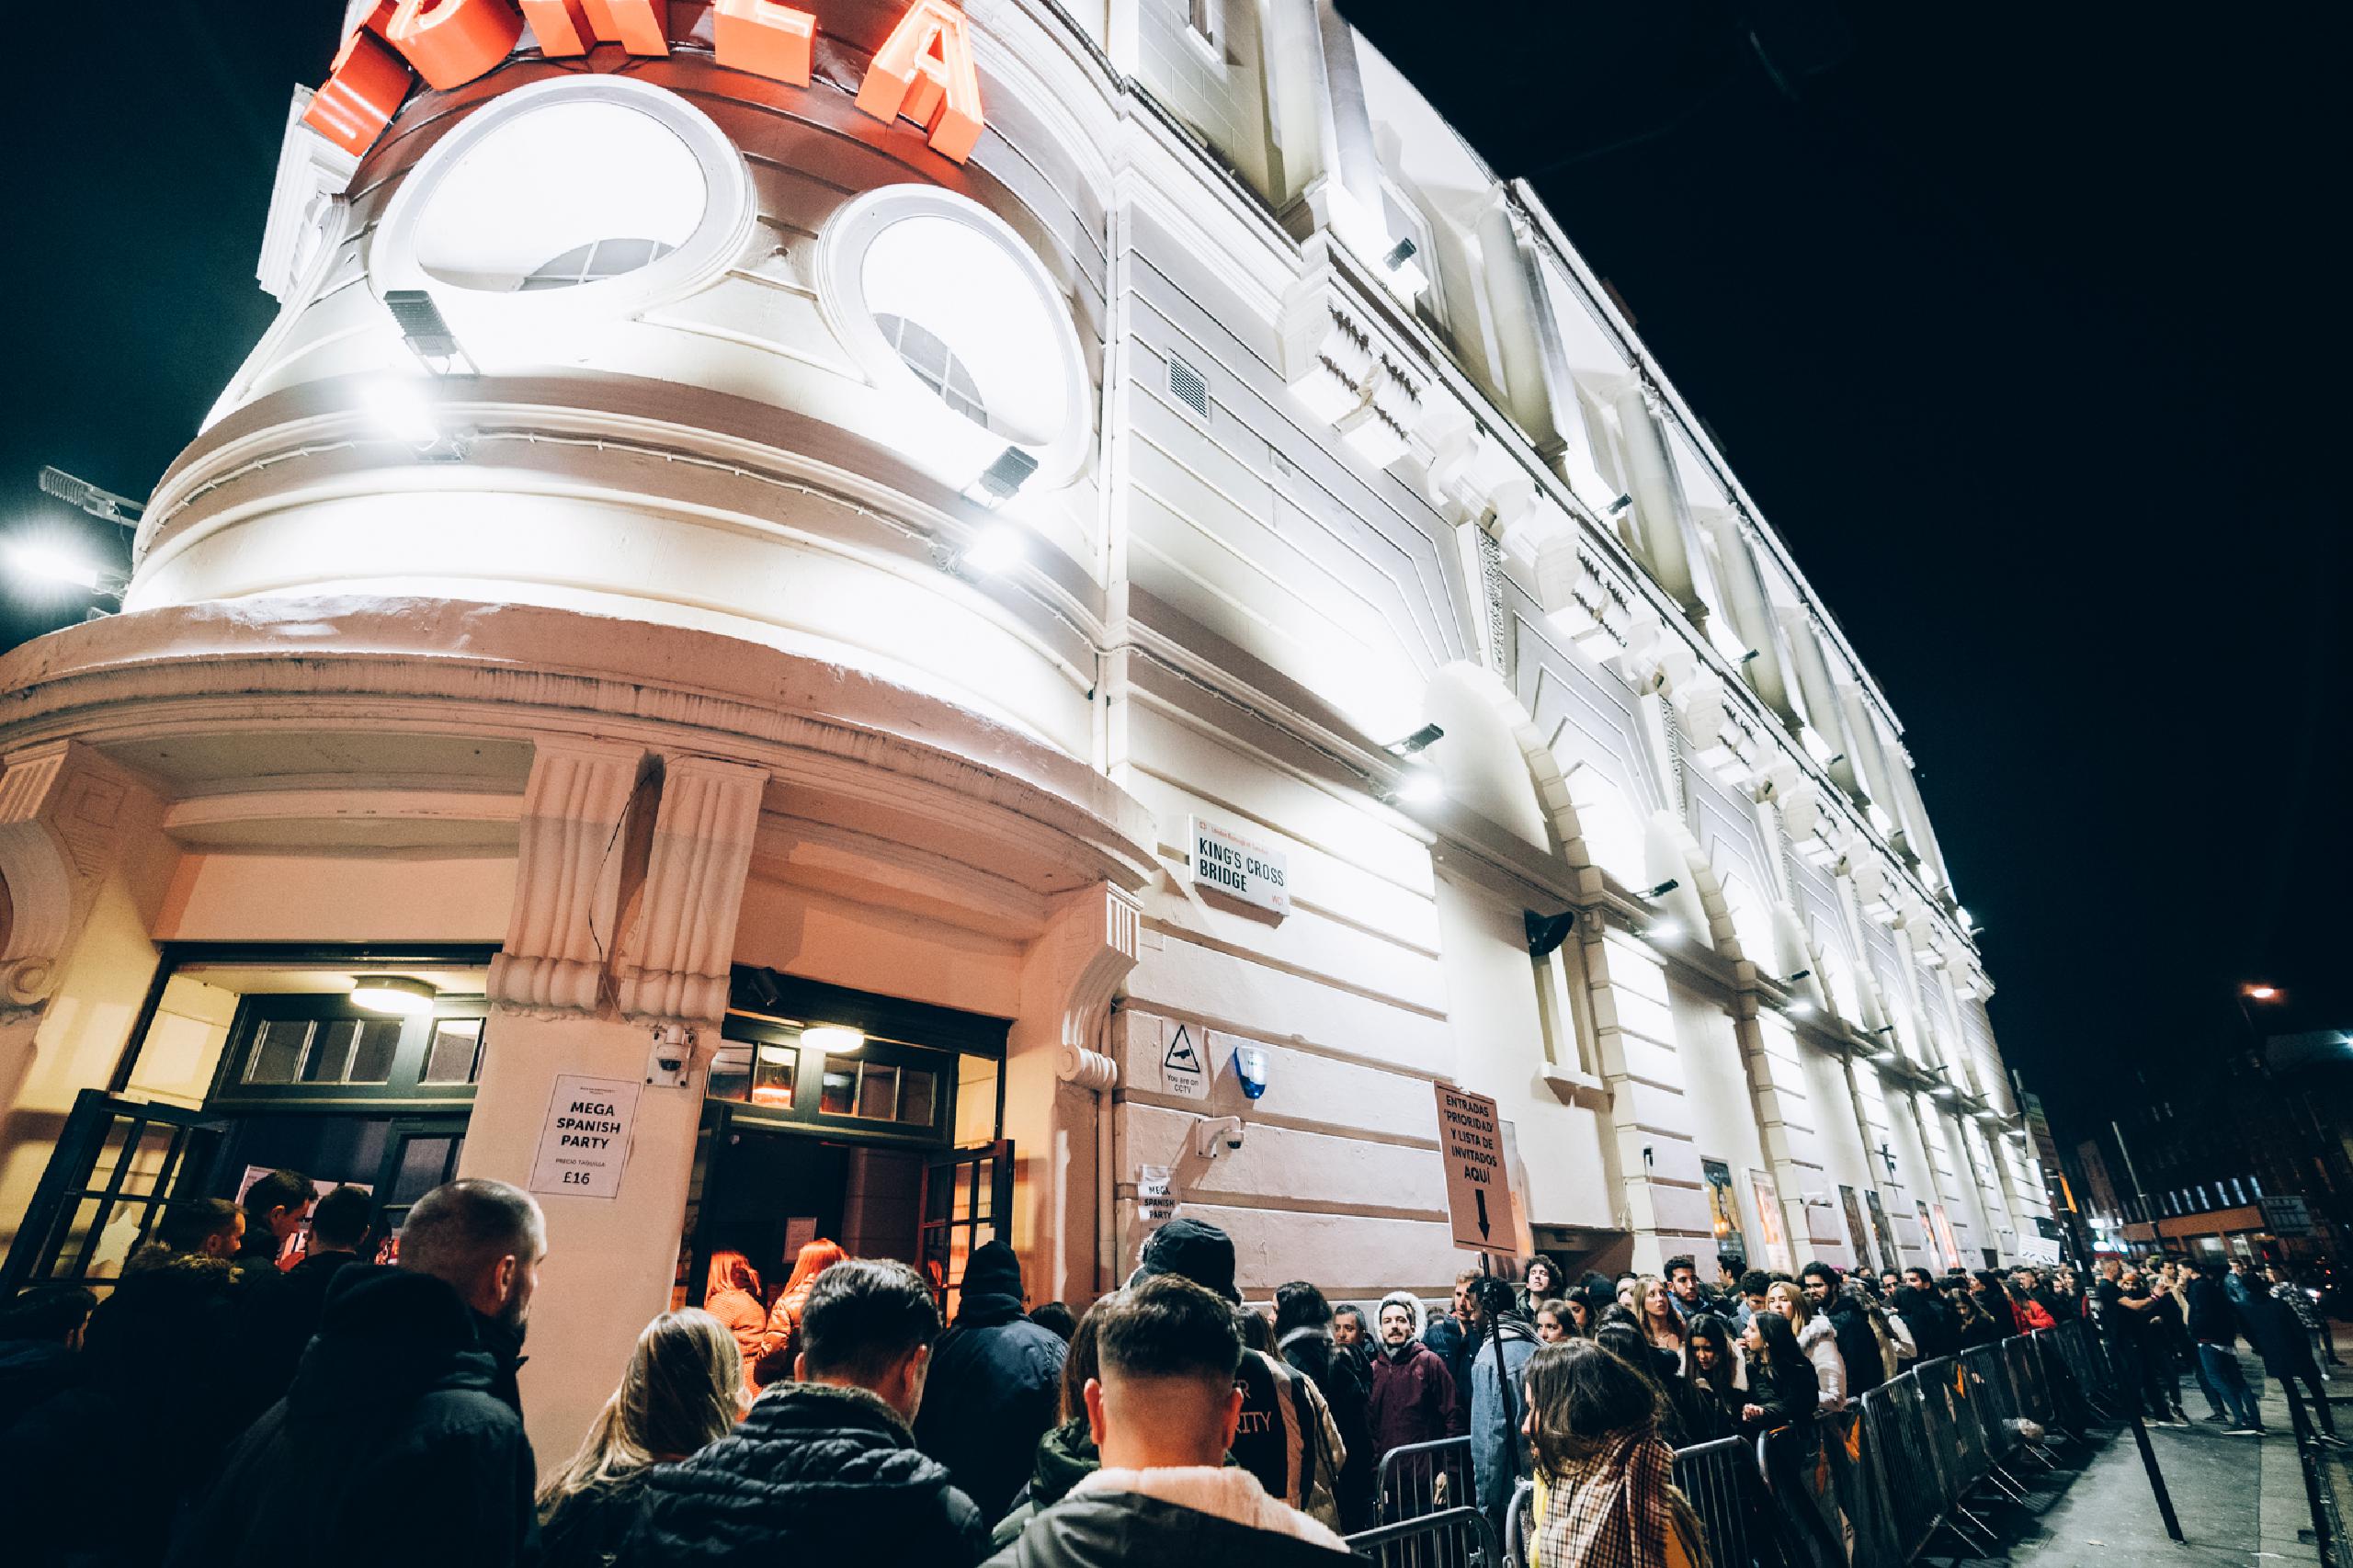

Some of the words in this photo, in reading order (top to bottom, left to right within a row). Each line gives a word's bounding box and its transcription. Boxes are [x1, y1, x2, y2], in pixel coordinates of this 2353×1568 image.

[1199, 837, 1242, 869] KING'S
[1246, 857, 1284, 887] CROSS
[1199, 858, 1247, 892] BRIDGE
[1167, 1074, 1178, 1083] You
[1179, 1076, 1190, 1085] are
[1174, 1084, 1192, 1094] CCTV
[570, 1101, 615, 1116] MEGA
[1446, 1094, 1490, 1118] ENTRADAS
[556, 1118, 620, 1134] SPANISH
[561, 1134, 609, 1149] PARTY
[1450, 1127, 1458, 1140] Y
[1459, 1131, 1481, 1146] LISTA
[1483, 1136, 1494, 1150] DE
[1451, 1144, 1497, 1167] INVITADOS
[562, 1171, 590, 1185] £16
[1149, 1186, 1170, 1195] MEGA
[1144, 1198, 1176, 1207] SPANISH
[1149, 1210, 1172, 1220] PARTY
